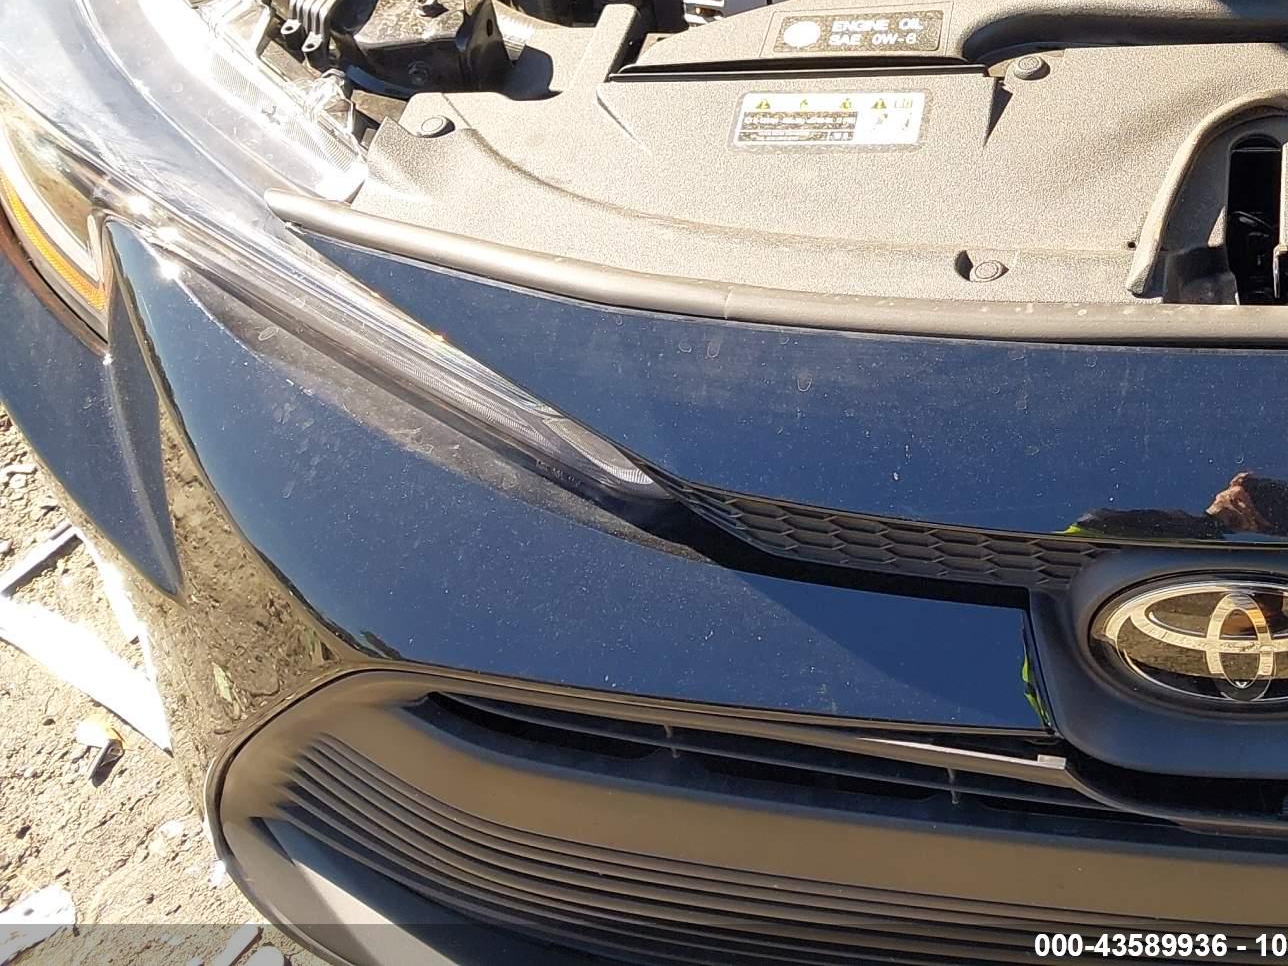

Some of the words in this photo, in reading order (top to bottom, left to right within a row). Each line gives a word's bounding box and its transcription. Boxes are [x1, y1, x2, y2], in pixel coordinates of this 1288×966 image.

[831, 19, 889, 32] ENGINE
[899, 18, 924, 30] OIL
[829, 34, 862, 46] SAE
